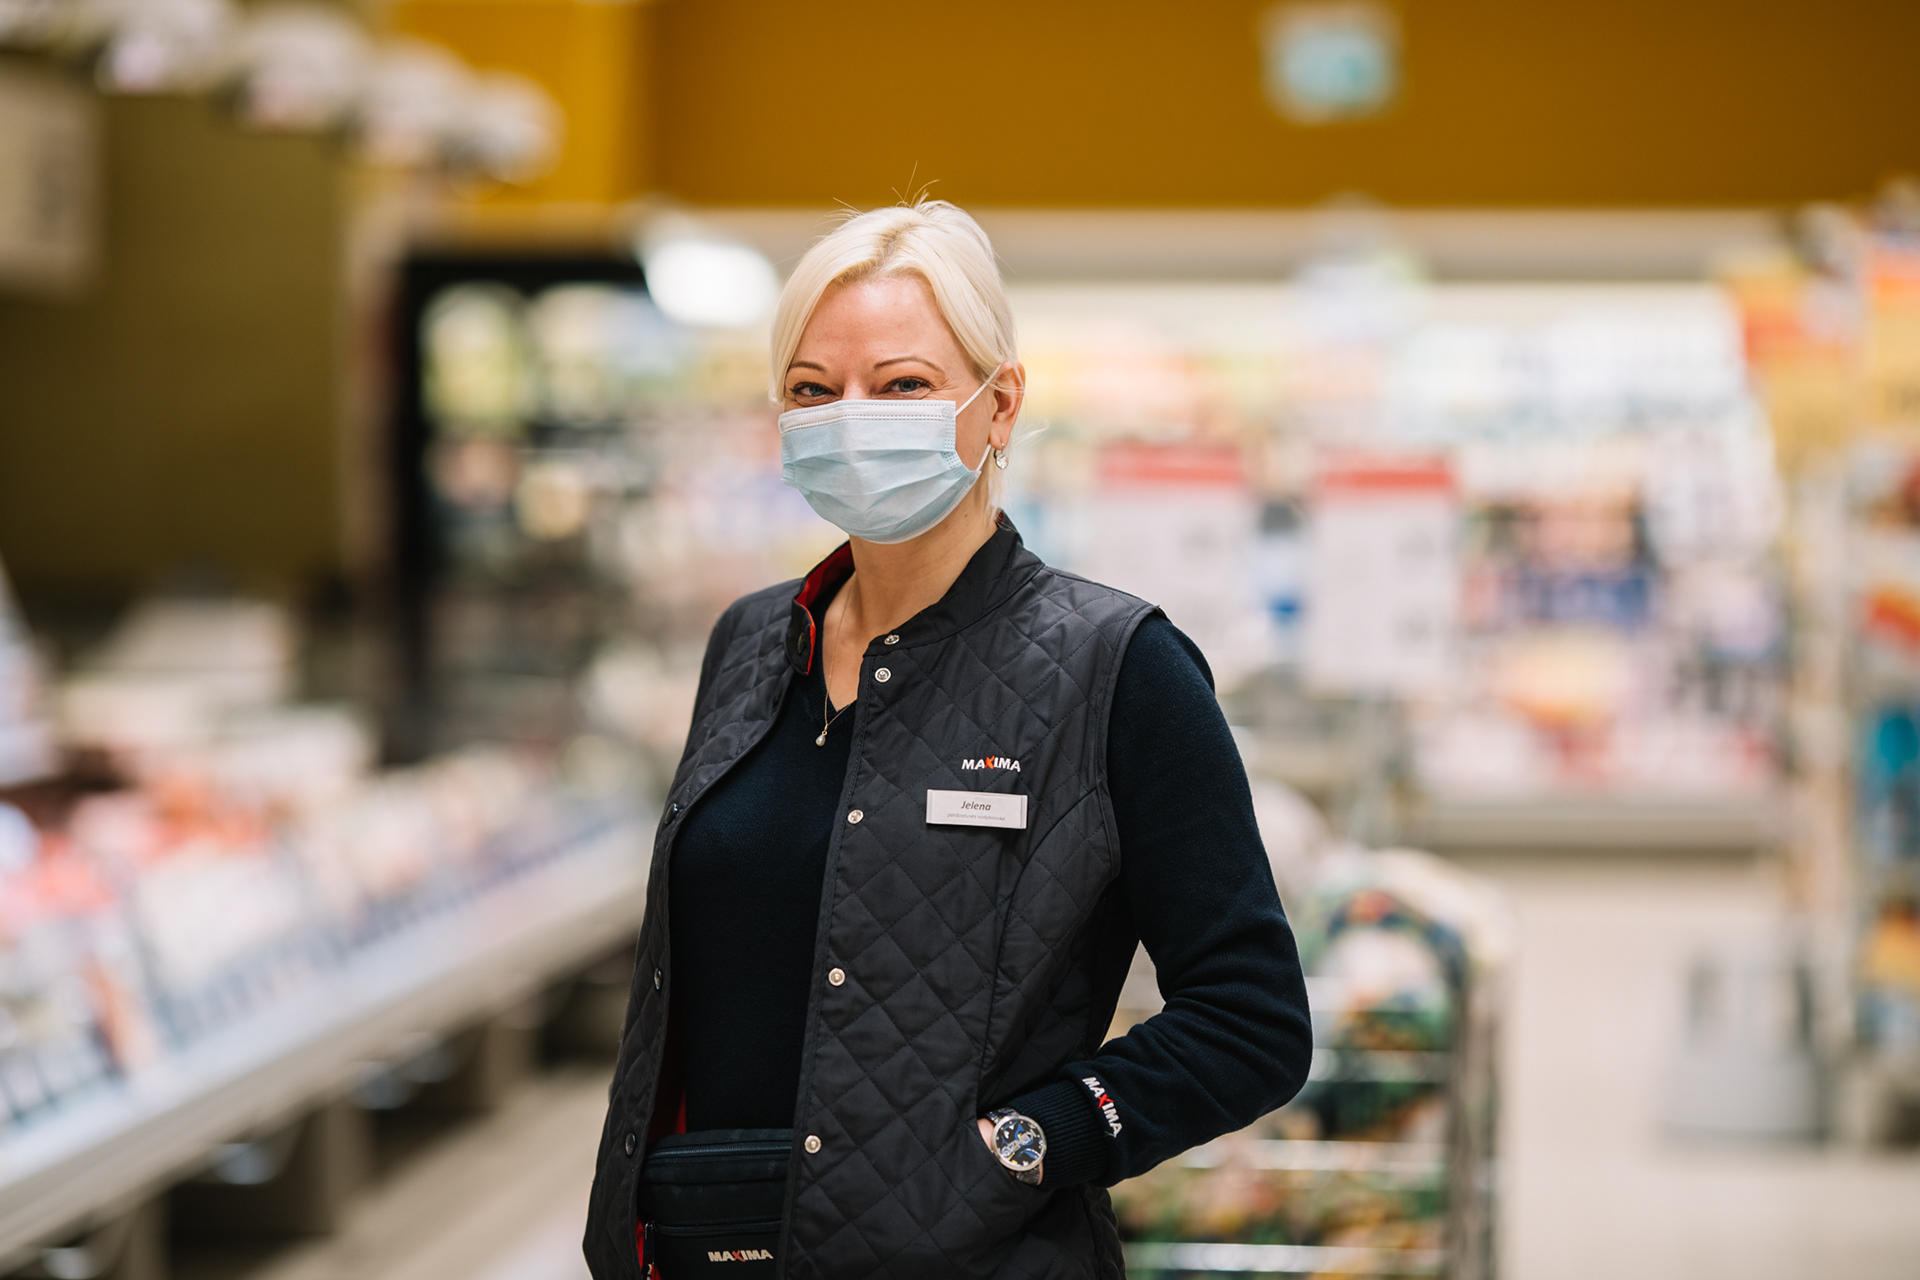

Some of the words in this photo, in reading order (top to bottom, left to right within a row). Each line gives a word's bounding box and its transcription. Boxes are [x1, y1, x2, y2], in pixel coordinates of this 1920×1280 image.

[961, 755, 1021, 773] MAXIMA
[960, 801, 992, 811] Jelena
[1082, 1076, 1122, 1138] MAXIMA
[1001, 1128, 1037, 1157] KENZO
[707, 1249, 774, 1262] MAXIMA
